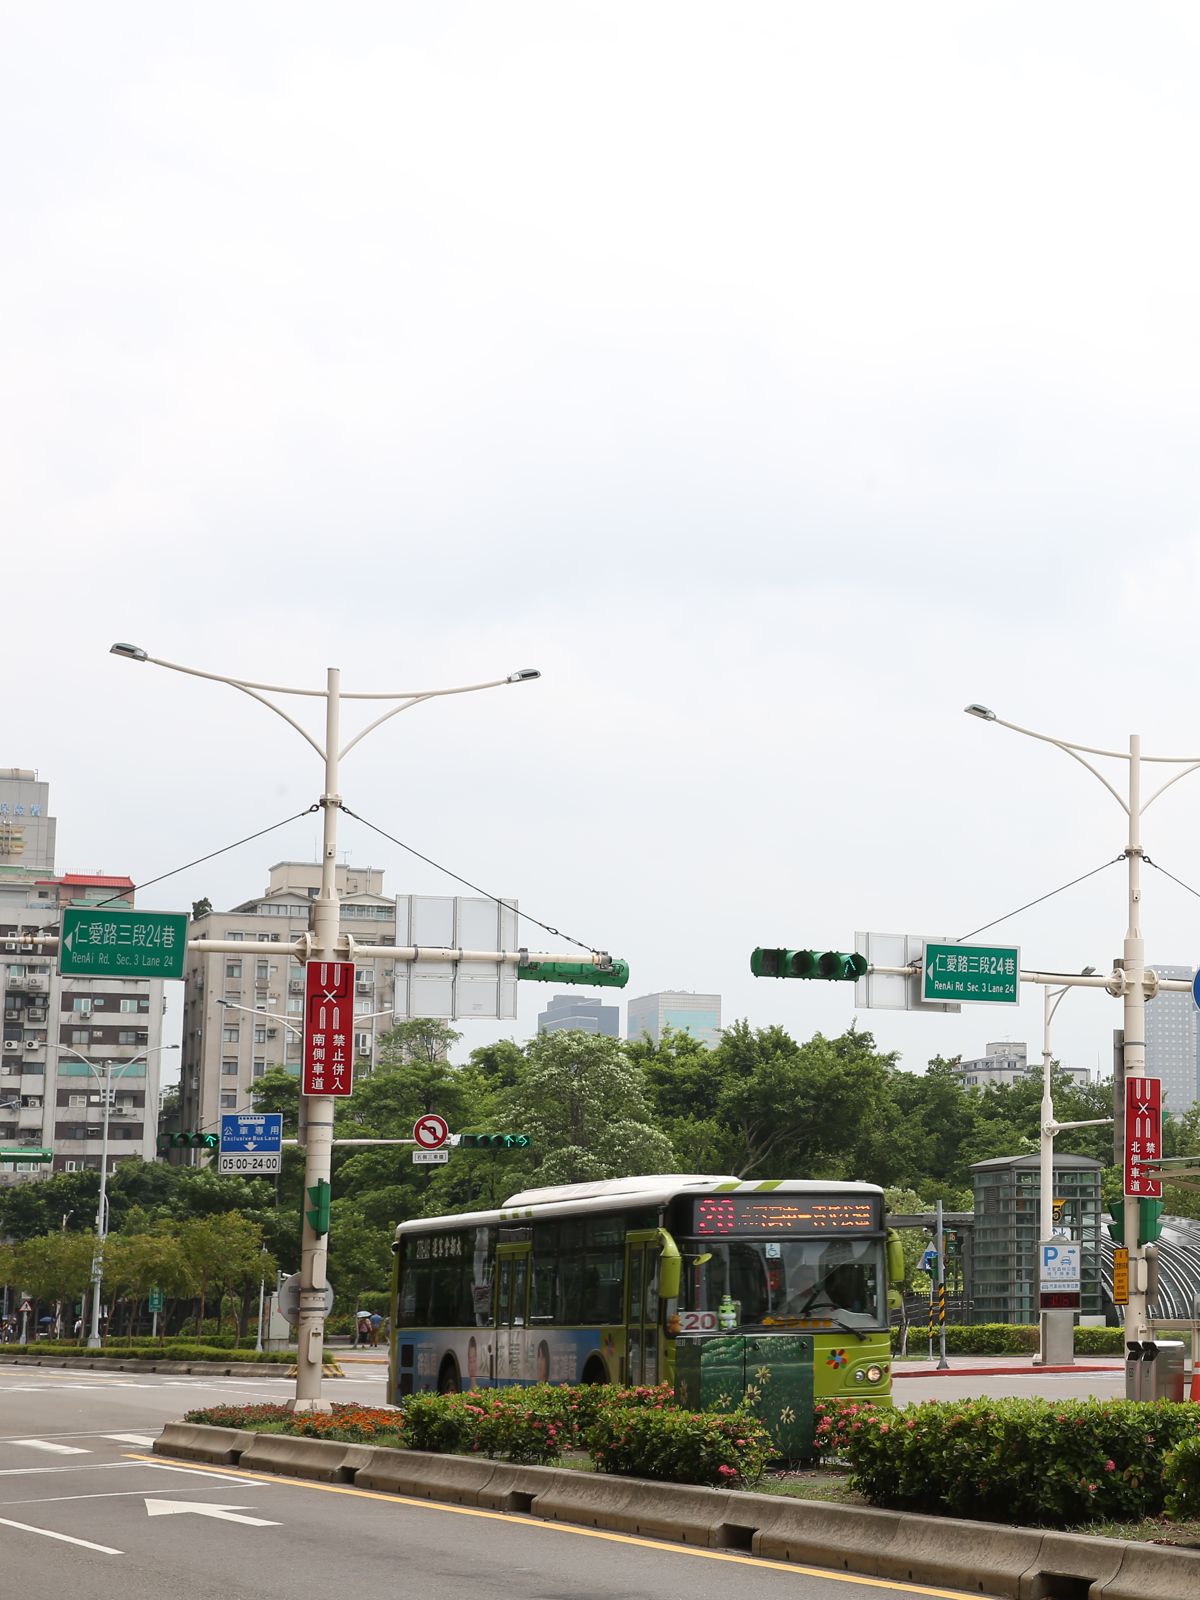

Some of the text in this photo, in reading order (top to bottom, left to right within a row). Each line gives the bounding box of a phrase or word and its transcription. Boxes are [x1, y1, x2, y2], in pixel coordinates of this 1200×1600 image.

[74, 921, 175, 948] 仁愛路三段24巷
[72, 952, 94, 964] RenAi
[98, 953, 110, 965] Rd.
[142, 955, 160, 966] Lane
[164, 956, 173, 967] 24
[935, 954, 1015, 975] 仁愛路三段24巷
[934, 980, 954, 991] RenAi
[982, 983, 986, 992] 3
[988, 983, 1004, 993] Lane
[1005, 984, 1014, 994] 24
[311, 1033, 326, 1090] 南側車道
[331, 1033, 346, 1090] 禁止併入
[224, 1126, 279, 1135] 公車專用
[1130, 1141, 1141, 1192] 北側車道
[1146, 1141, 1156, 1192] 禁入
[1043, 1246, 1059, 1267] P
[685, 1313, 717, 1330] 20
